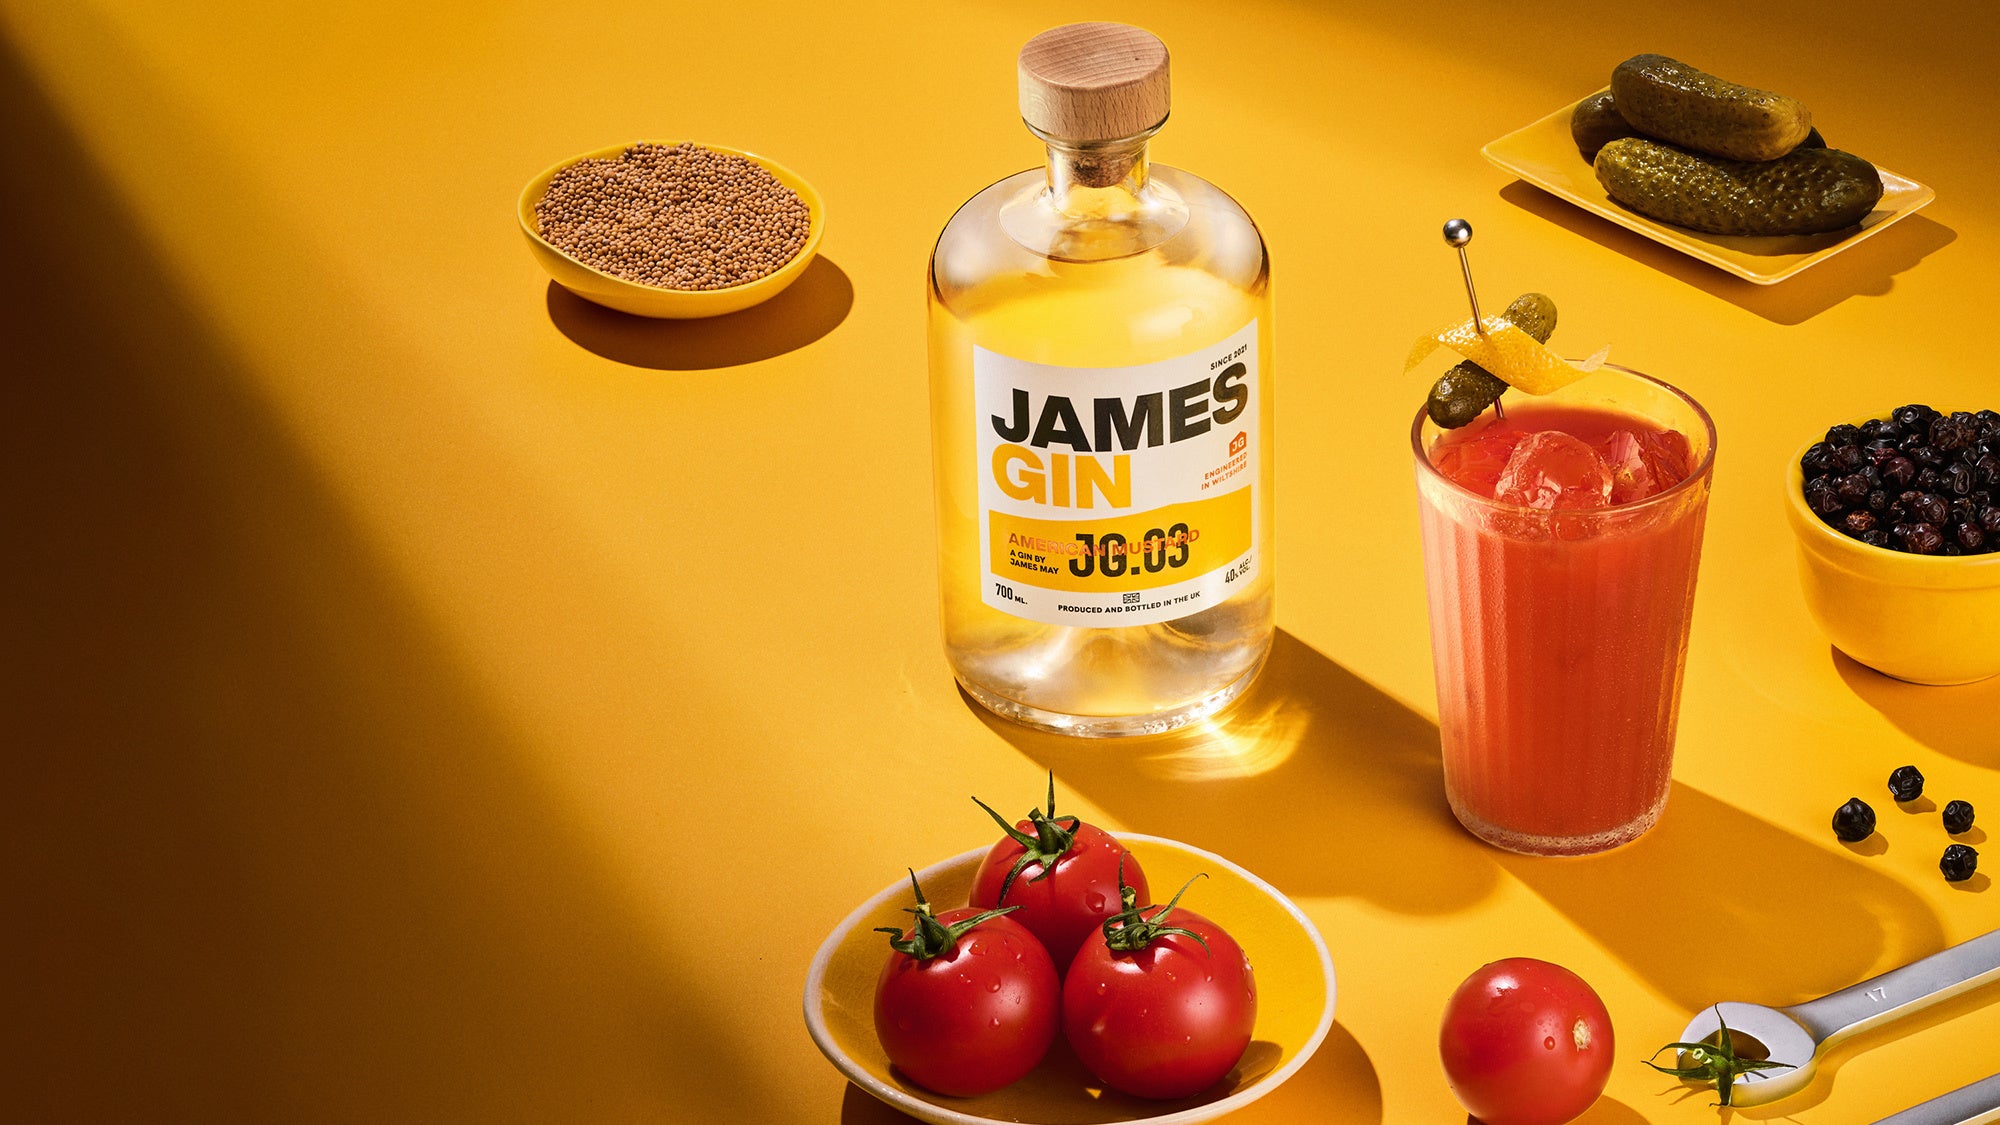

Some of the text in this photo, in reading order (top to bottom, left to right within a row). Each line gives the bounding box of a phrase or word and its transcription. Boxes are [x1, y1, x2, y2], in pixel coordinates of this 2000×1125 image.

[1211, 344, 1247, 370] SINCE 2021
[991, 362, 1248, 452] JAMES
[1232, 436, 1245, 451] JG
[992, 443, 1131, 509] GIN
[1201, 462, 1247, 490] IN WILTSHIRE
[1204, 452, 1247, 479] ENGINEERED
[1008, 529, 1200, 556] AMERICAN MUSTARD
[1069, 523, 1189, 578] JG.03
[1010, 559, 1059, 575] JAMES MAY
[1019, 551, 1033, 561] GIN
[1035, 554, 1046, 563] BY
[995, 583, 1013, 600] 700
[1058, 604, 1103, 614] PRODUCED
[1125, 602, 1161, 613] BOTTLED
[1164, 598, 1172, 607] IN
[1174, 595, 1188, 604] THE
[1190, 590, 1200, 600] UK
[1865, 986, 1887, 1002] 17
